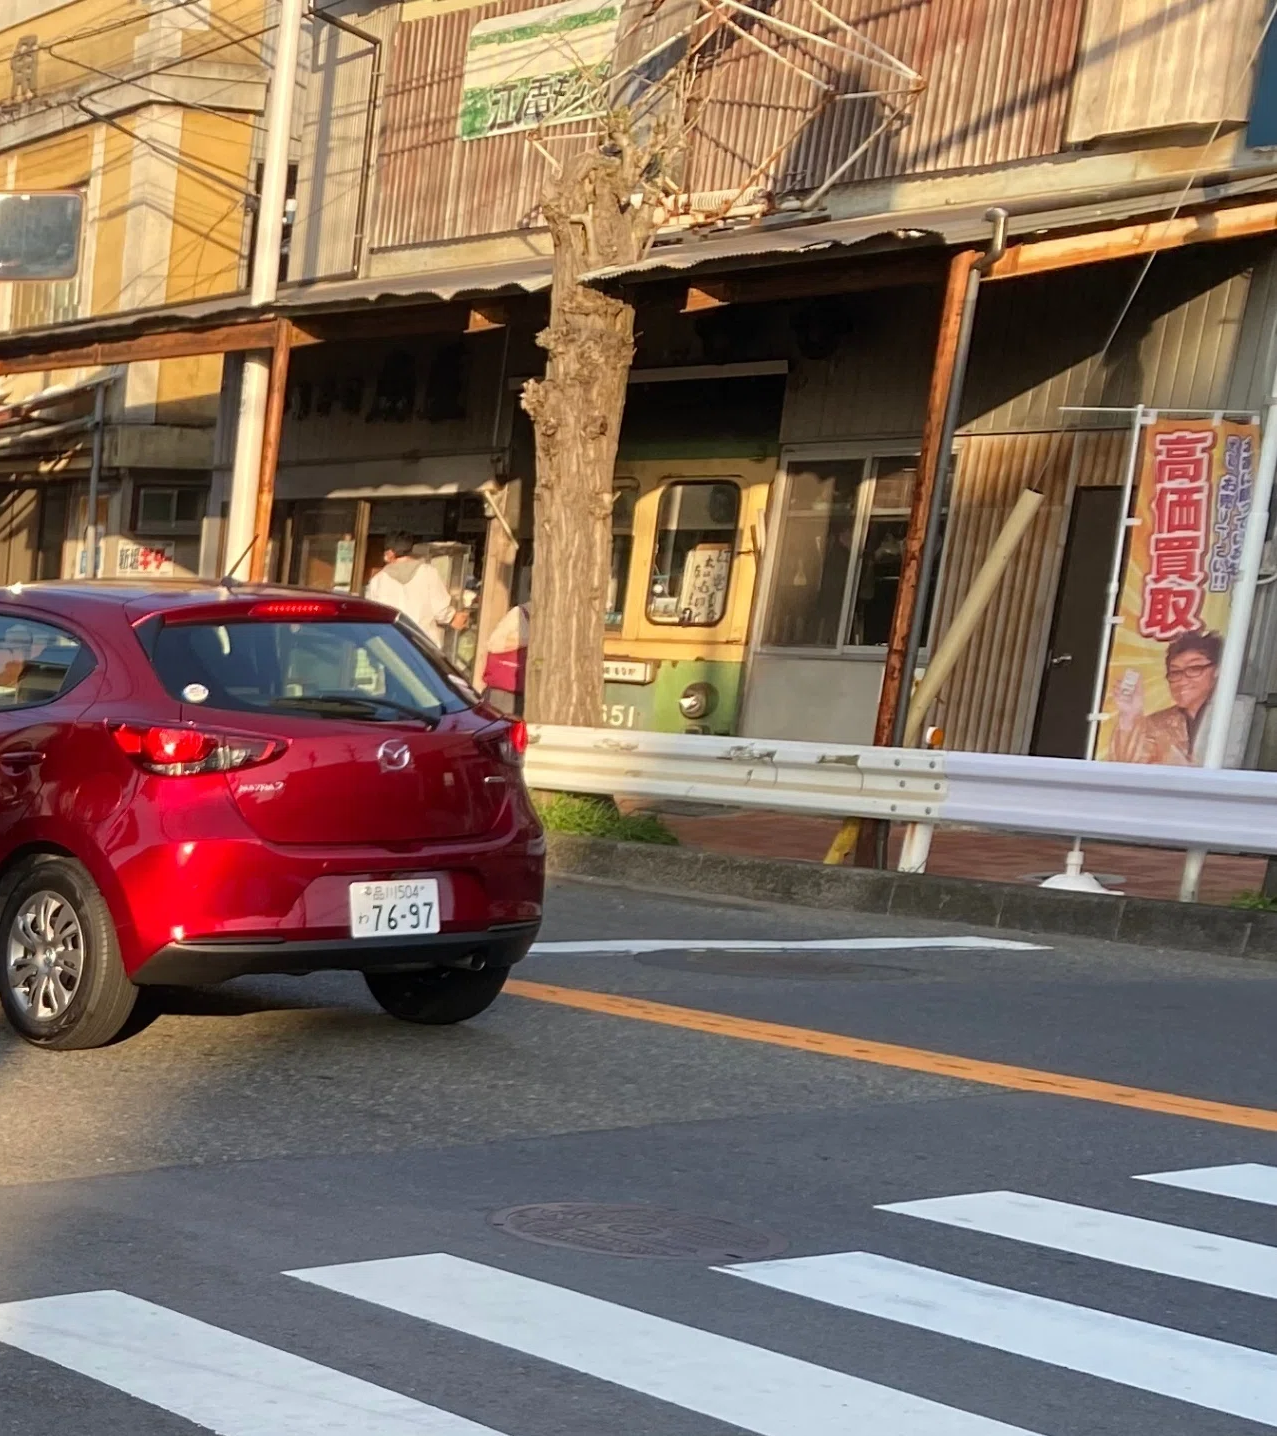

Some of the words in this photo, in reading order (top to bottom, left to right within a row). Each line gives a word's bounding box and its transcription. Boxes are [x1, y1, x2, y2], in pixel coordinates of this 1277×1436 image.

[1141, 431, 1215, 638] 高価買取
[398, 884, 420, 900] 504
[372, 902, 434, 931] 76-97
